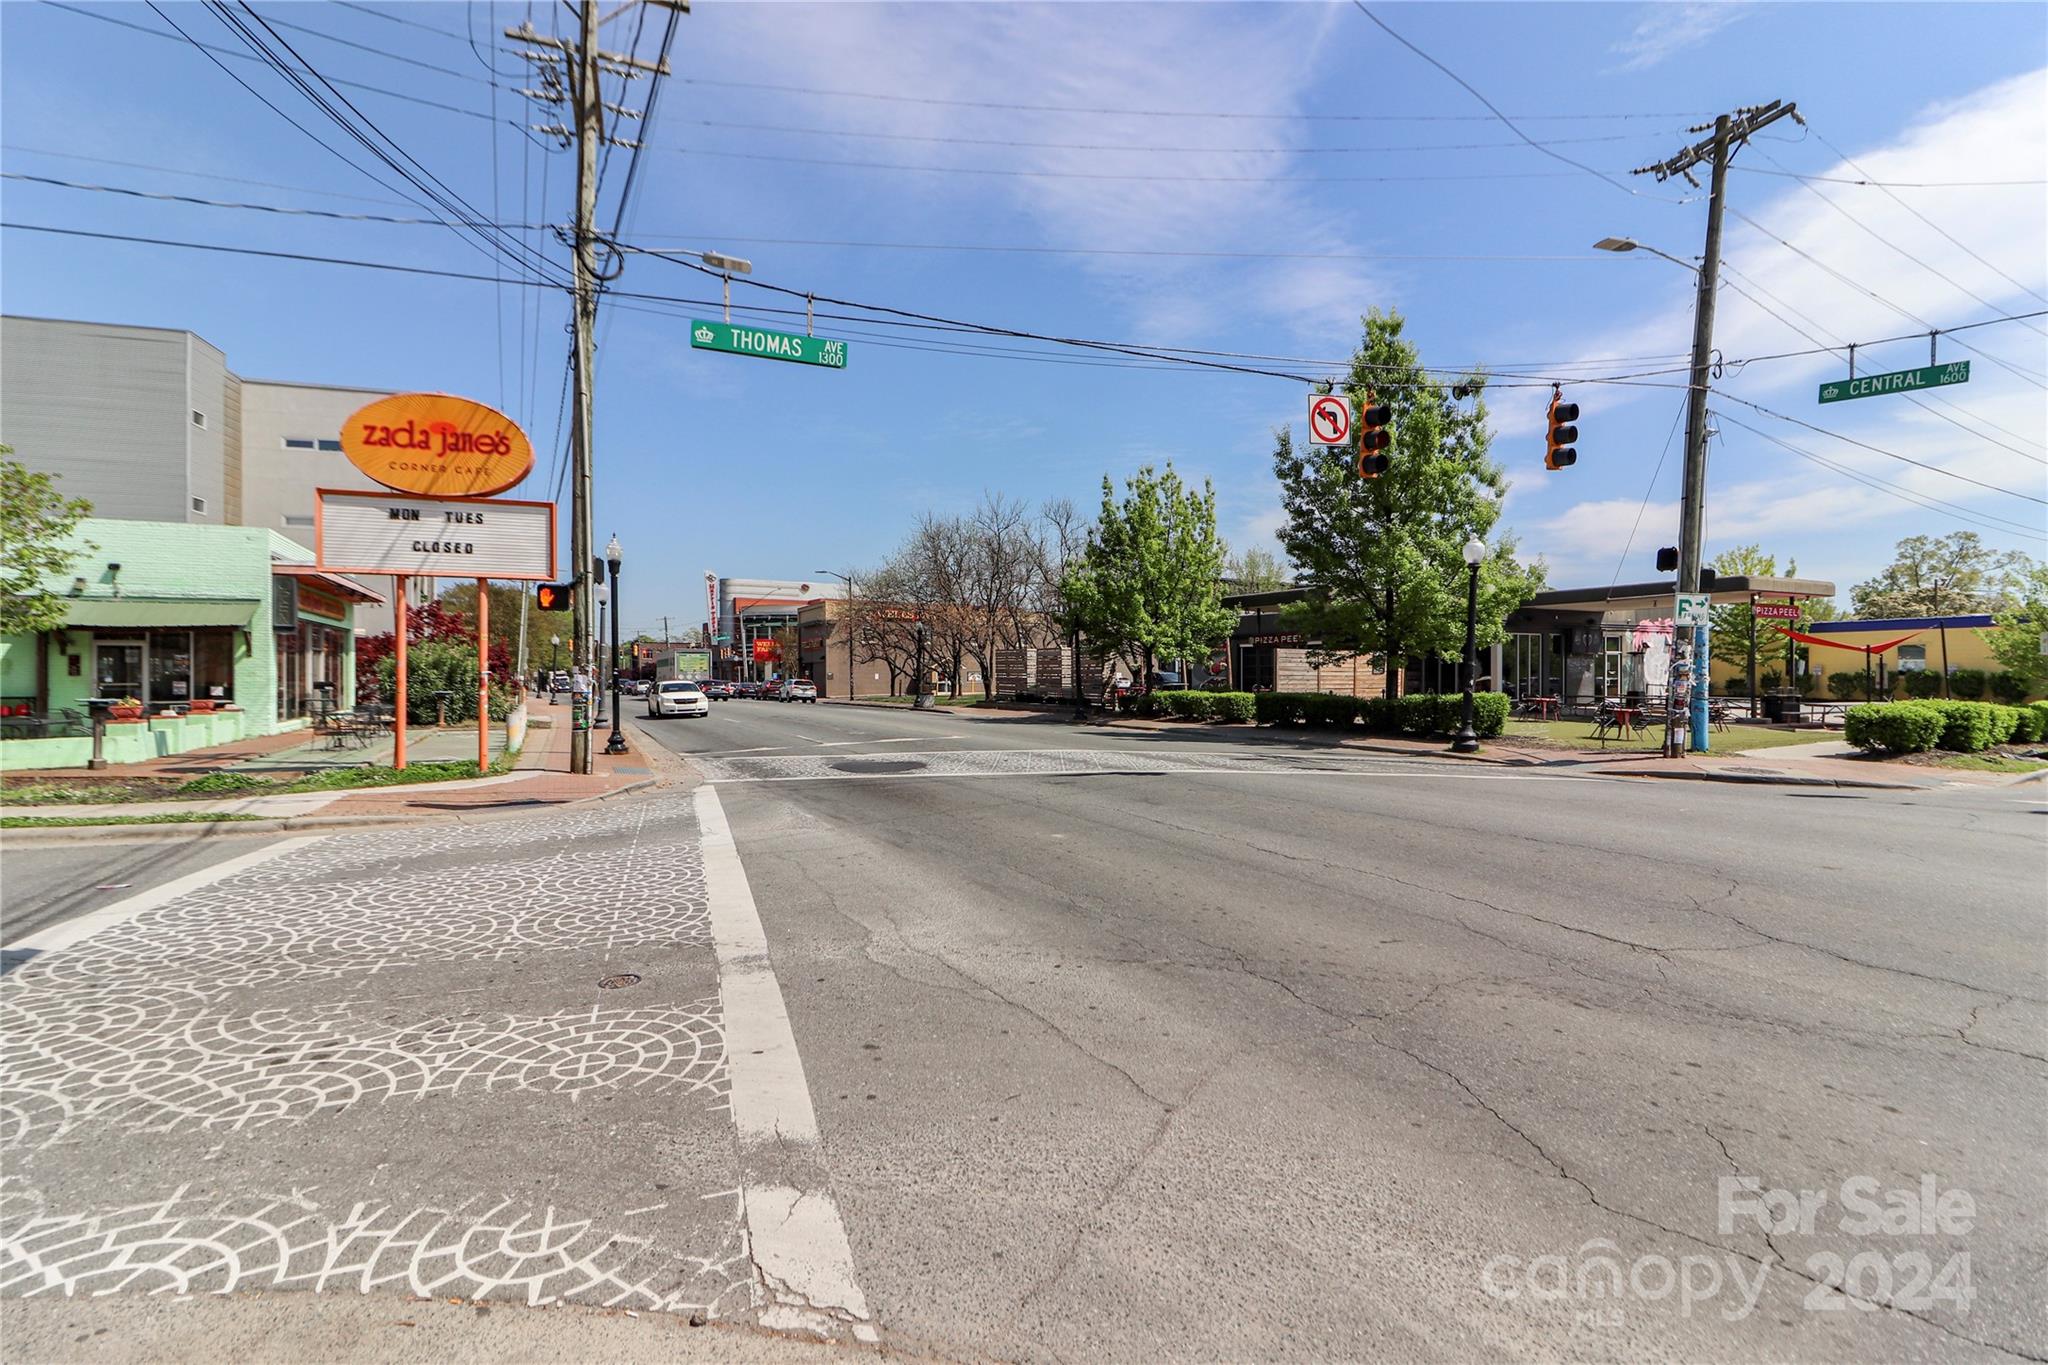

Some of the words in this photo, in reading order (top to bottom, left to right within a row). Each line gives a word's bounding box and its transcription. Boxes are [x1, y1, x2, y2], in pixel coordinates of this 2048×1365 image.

[730, 329, 802, 357] THOMAS
[823, 340, 844, 354] AVE
[818, 351, 844, 366] 1300
[1946, 362, 1967, 373] AVE
[1849, 371, 1926, 395] CENTRAL
[1940, 372, 1967, 384] 1600
[388, 461, 446, 473] CORNER
[389, 507, 420, 521] MON
[445, 511, 484, 524] TUES
[412, 540, 474, 554] CLOSED
[1756, 606, 1778, 616] PIZZA
[1779, 607, 1798, 617] PEEL
[1254, 636, 1279, 644] PIZZA
